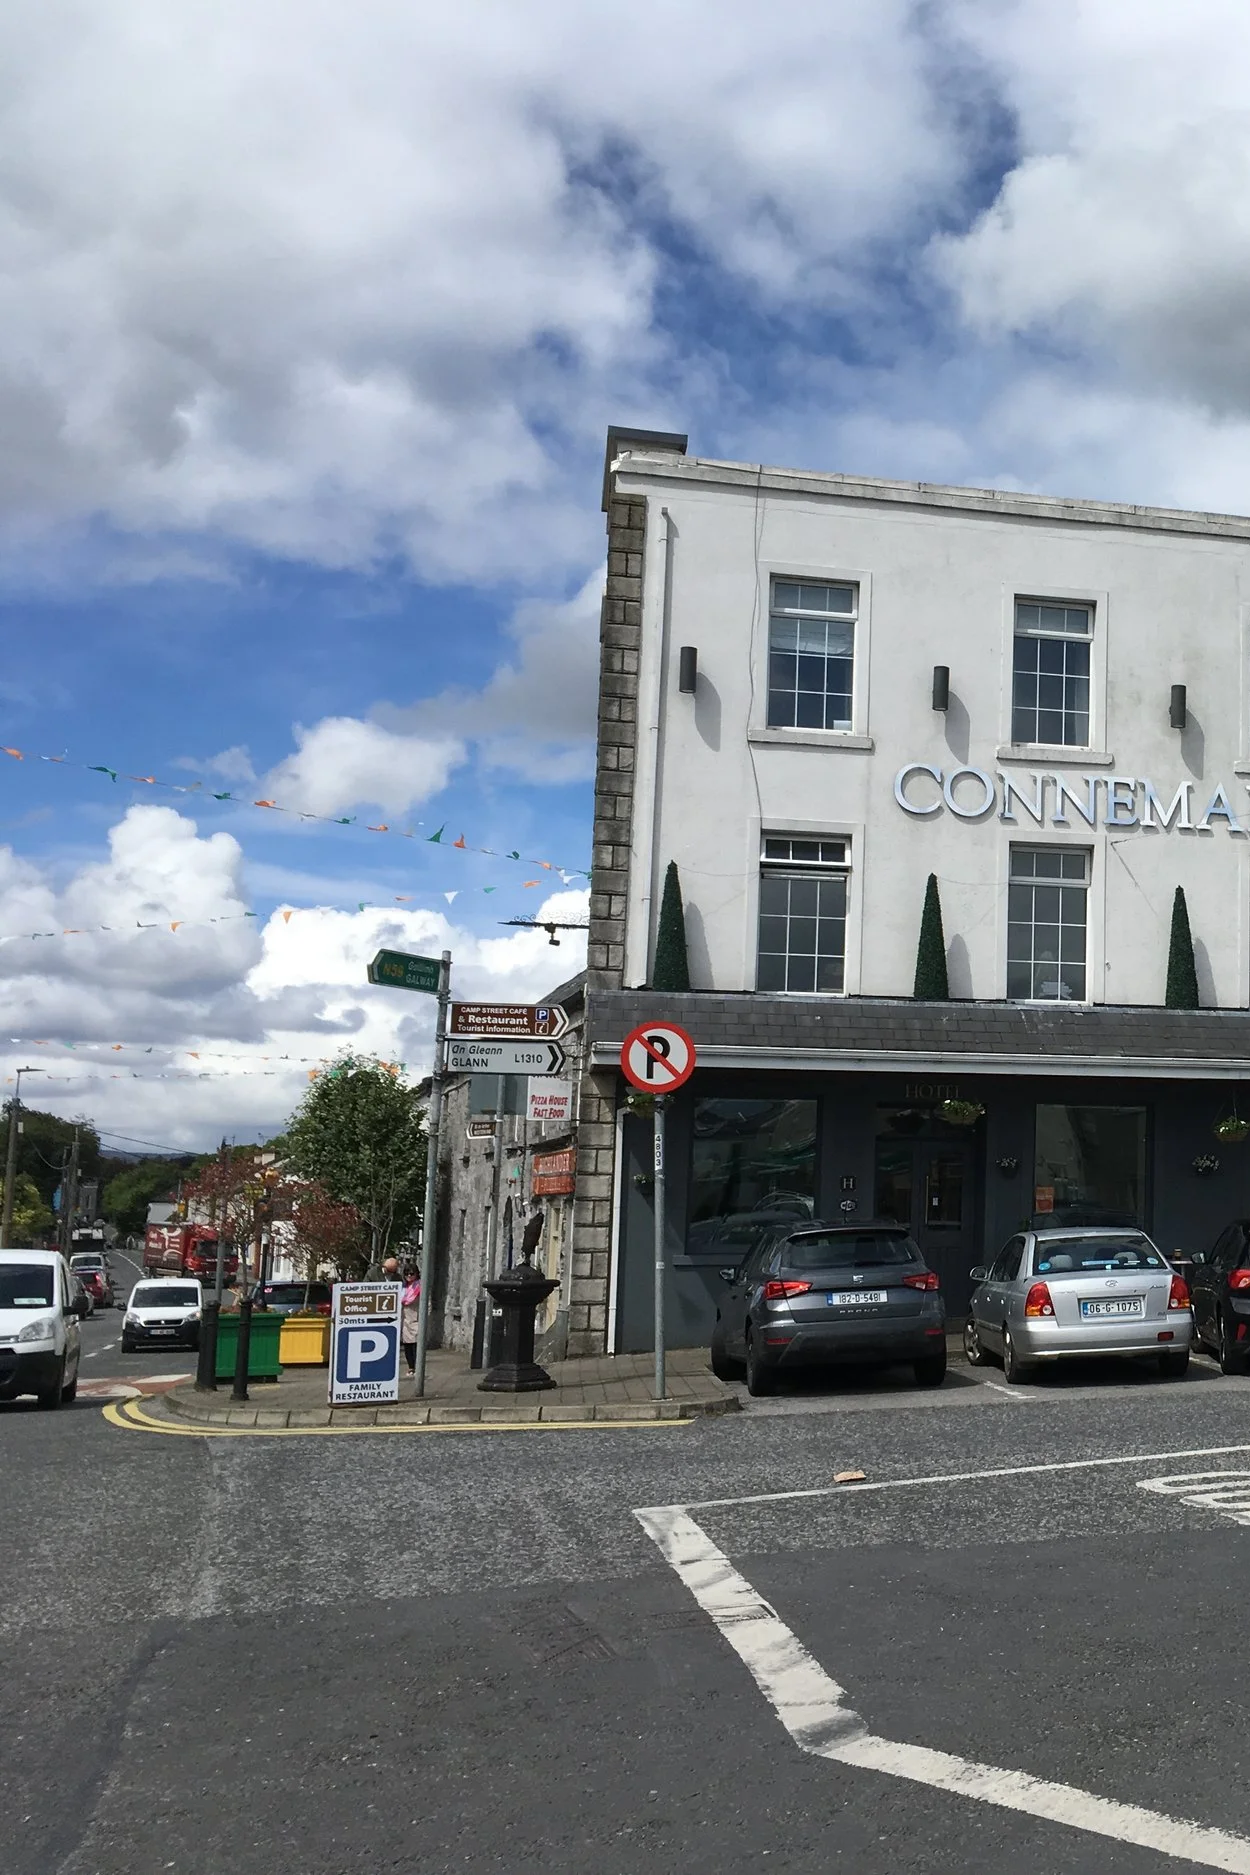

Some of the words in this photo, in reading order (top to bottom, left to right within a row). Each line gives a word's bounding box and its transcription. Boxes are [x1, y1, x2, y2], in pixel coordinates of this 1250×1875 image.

[405, 973, 436, 988] GALWAY
[460, 1006, 481, 1014] CAMP
[468, 1015, 529, 1025] Restaurant
[457, 1024, 485, 1032] Tourist
[469, 1045, 503, 1055] Gleann
[451, 1058, 488, 1067] GLANN
[514, 1054, 543, 1064] L1310
[530, 1094, 547, 1105] PIZZA
[548, 1095, 568, 1106] HOUSE
[533, 1108, 548, 1118] FAST
[549, 1108, 565, 1118] FOOD
[344, 1295, 373, 1303] Tourist
[346, 1330, 389, 1379] P
[349, 1383, 382, 1391] FAMILY
[335, 1390, 395, 1401] RESTAURANT
